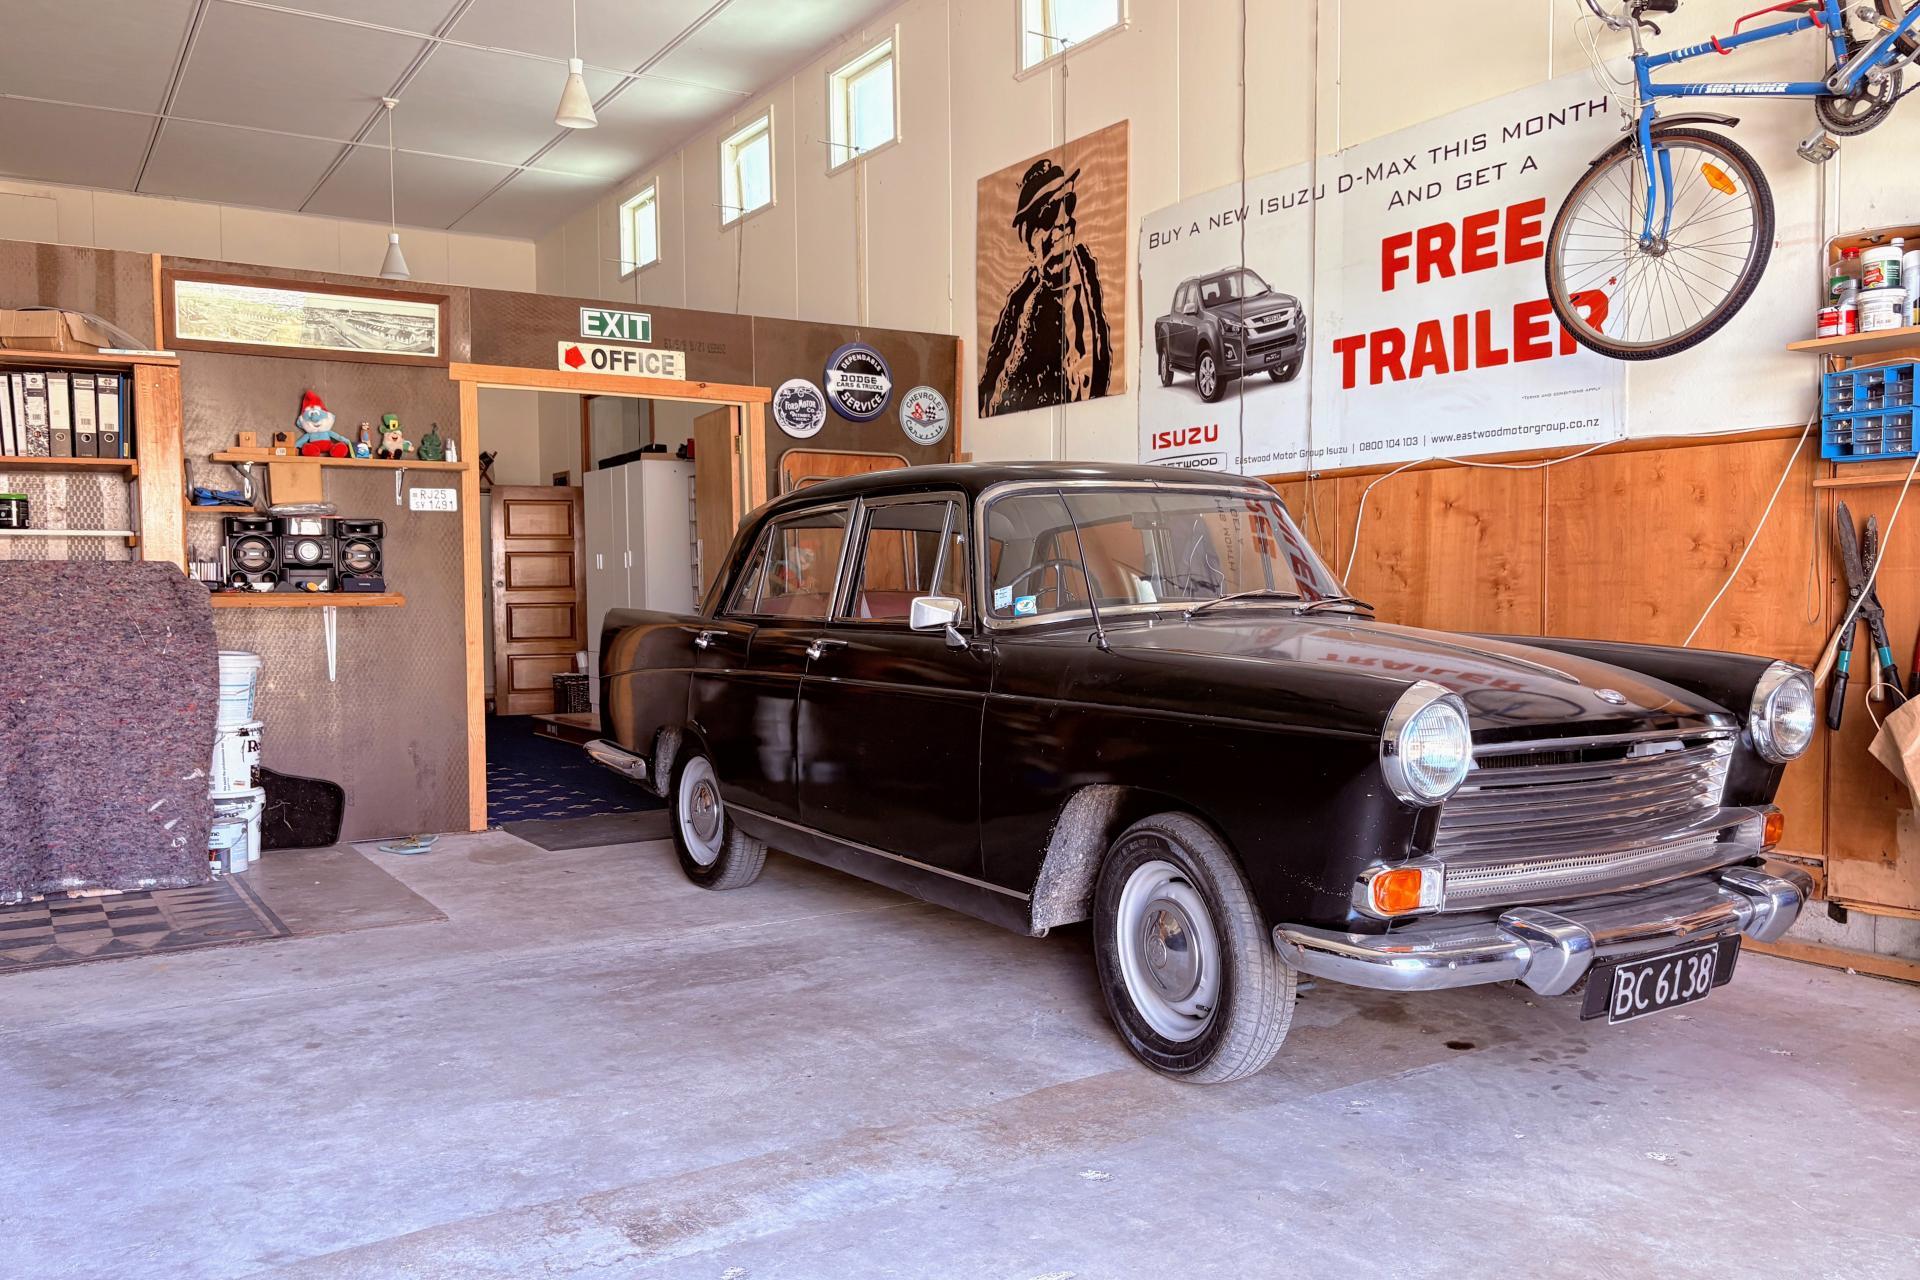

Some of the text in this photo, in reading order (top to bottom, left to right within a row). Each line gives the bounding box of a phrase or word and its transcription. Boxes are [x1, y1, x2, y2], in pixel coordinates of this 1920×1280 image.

[1149, 95, 1608, 249] BUY A NEW ISUZU D-MAX THIS MONTH
[1388, 155, 1538, 210] AND GET A
[1381, 197, 1546, 292] FREE
[583, 310, 649, 340] EXIT
[591, 348, 675, 376] OFFICE
[841, 353, 882, 372] DEPENDABLE
[840, 374, 878, 384] DODGE
[862, 383, 883, 391] TRUCKS
[841, 391, 882, 412] SERVICE
[906, 391, 944, 411] CHEVROLET
[1152, 424, 1218, 450] ISUZU
[1235, 418, 1600, 465] Eastwood Motor Group Isuzu 0800 104 103 www.eastwoodmotorgroup.co.nz
[420, 489, 447, 500] RJ25
[1614, 952, 1712, 1016] BC 6138
